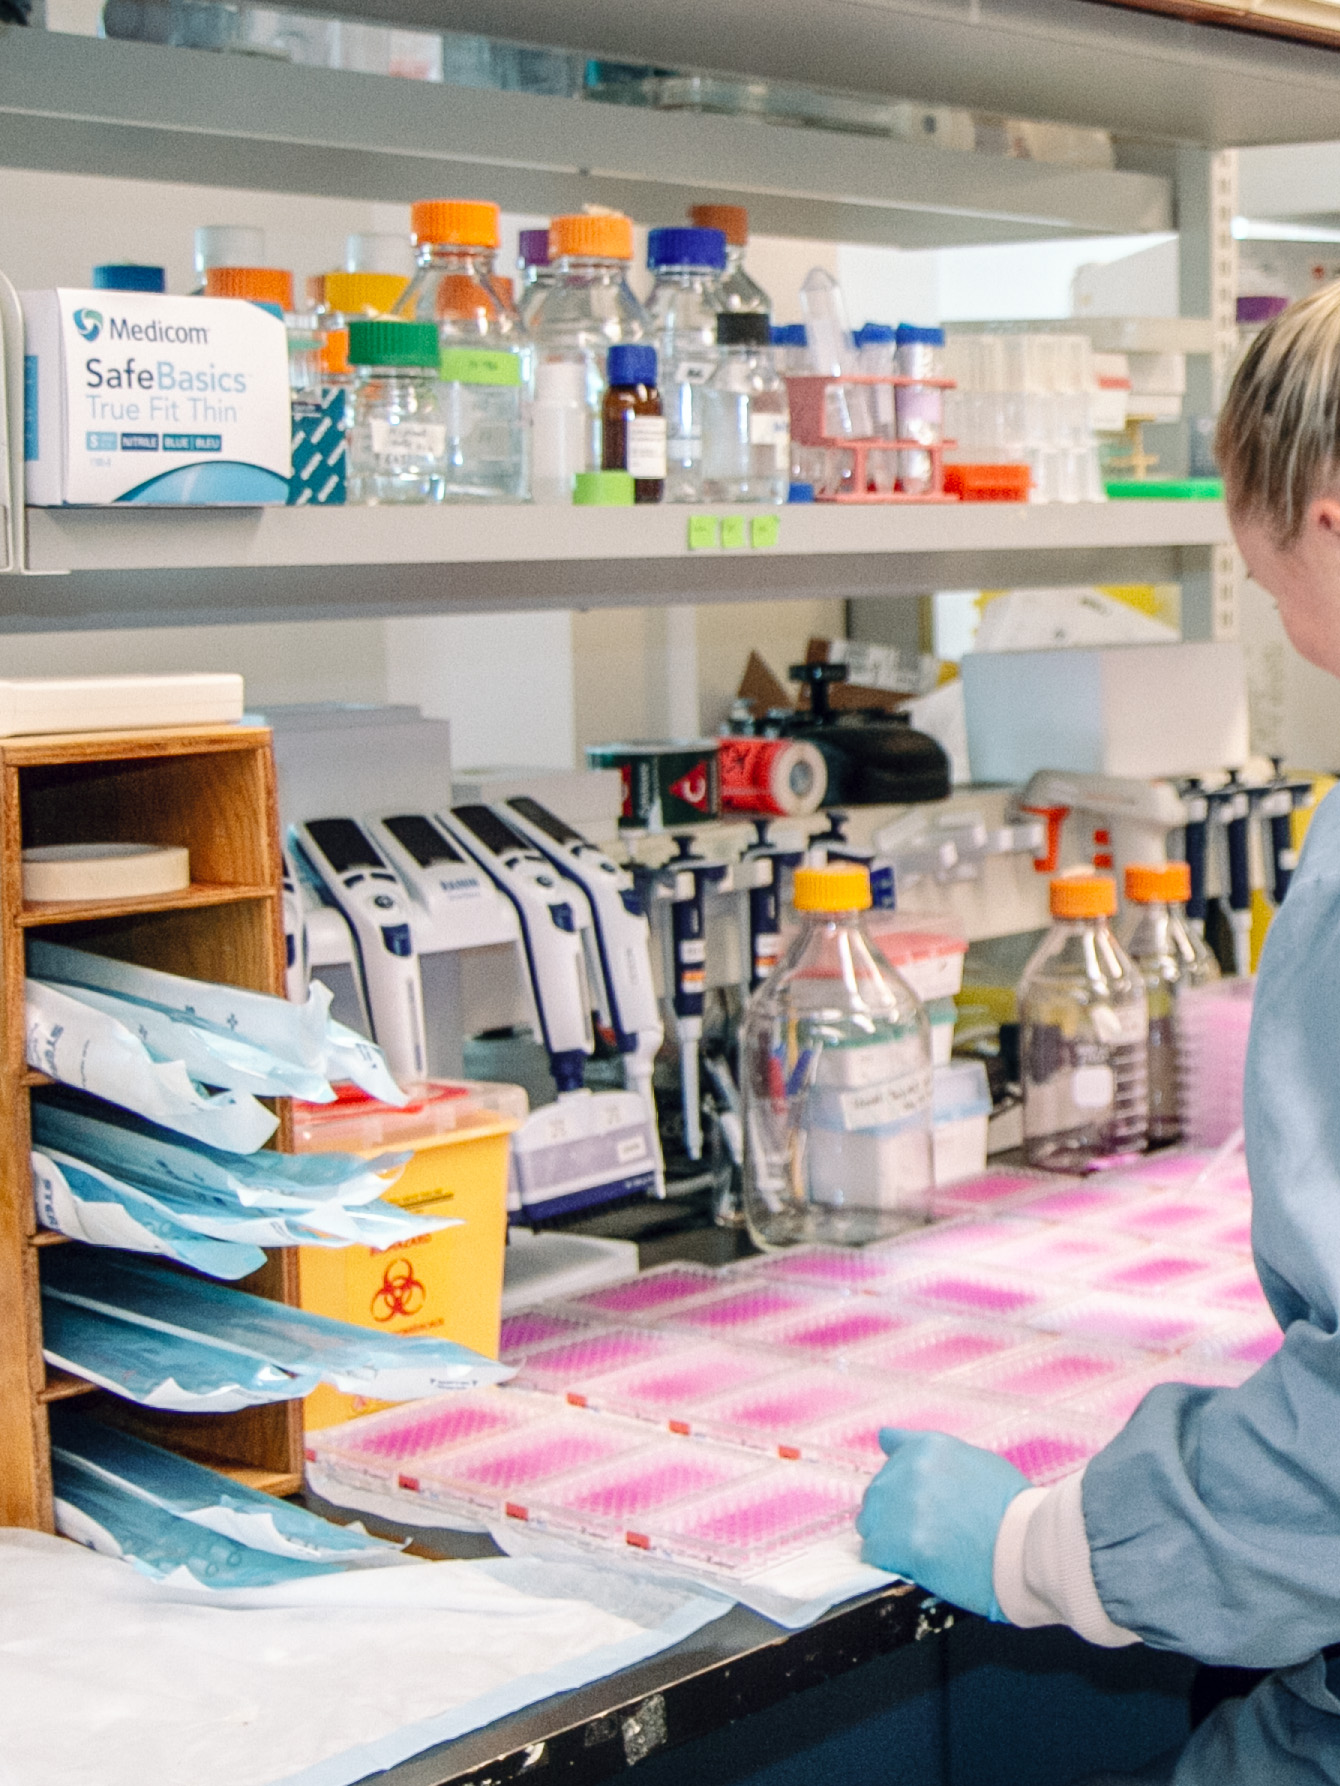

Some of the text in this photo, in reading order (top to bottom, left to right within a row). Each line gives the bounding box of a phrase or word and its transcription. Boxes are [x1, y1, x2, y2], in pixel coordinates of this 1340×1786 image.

[109, 317, 208, 344] Medicom
[85, 357, 247, 393] SafeBasics
[85, 394, 238, 423] True Fit Thin
[121, 436, 158, 449] NITRILE
[164, 436, 190, 450] BLUE
[195, 437, 221, 450] BLEU
